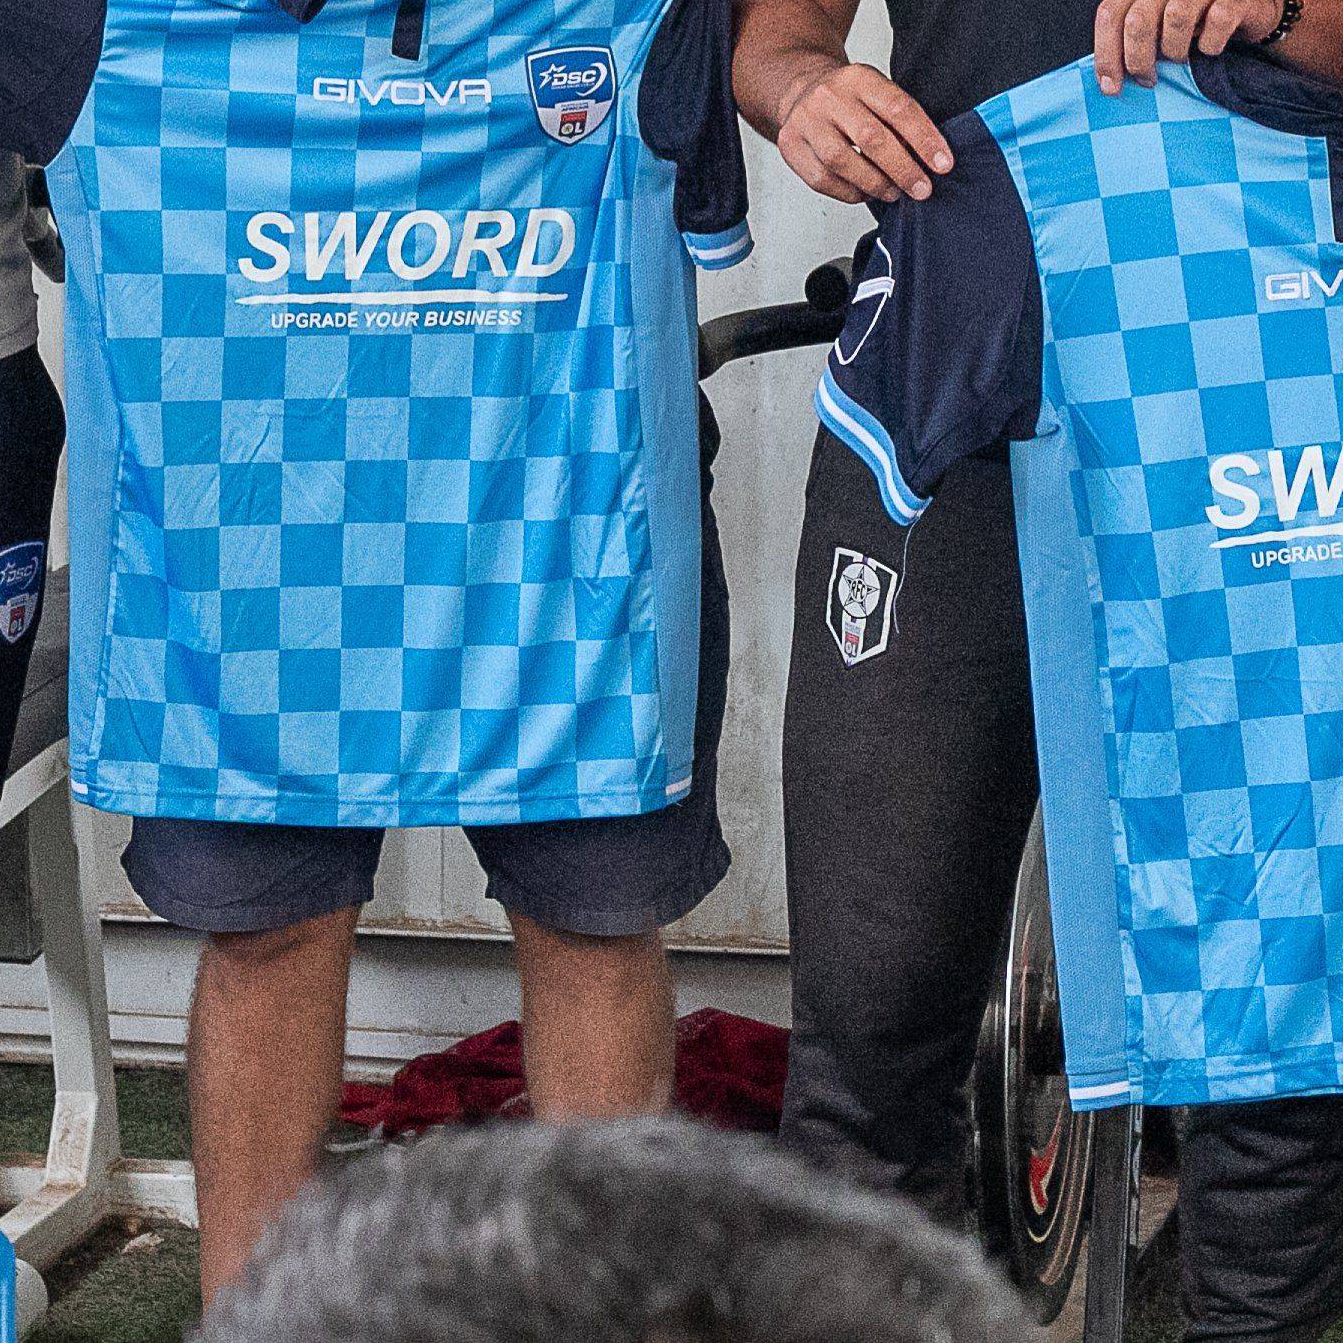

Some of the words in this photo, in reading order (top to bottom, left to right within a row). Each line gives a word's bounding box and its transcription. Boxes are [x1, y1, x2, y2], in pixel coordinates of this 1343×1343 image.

[312, 77, 492, 106] GIVOVA
[238, 208, 576, 283] SWORD
[271, 312, 358, 329] UPGRADE
[364, 311, 419, 328] YOUR
[424, 309, 522, 327] BUSINESS
[1251, 542, 1343, 569] UPGRADE
